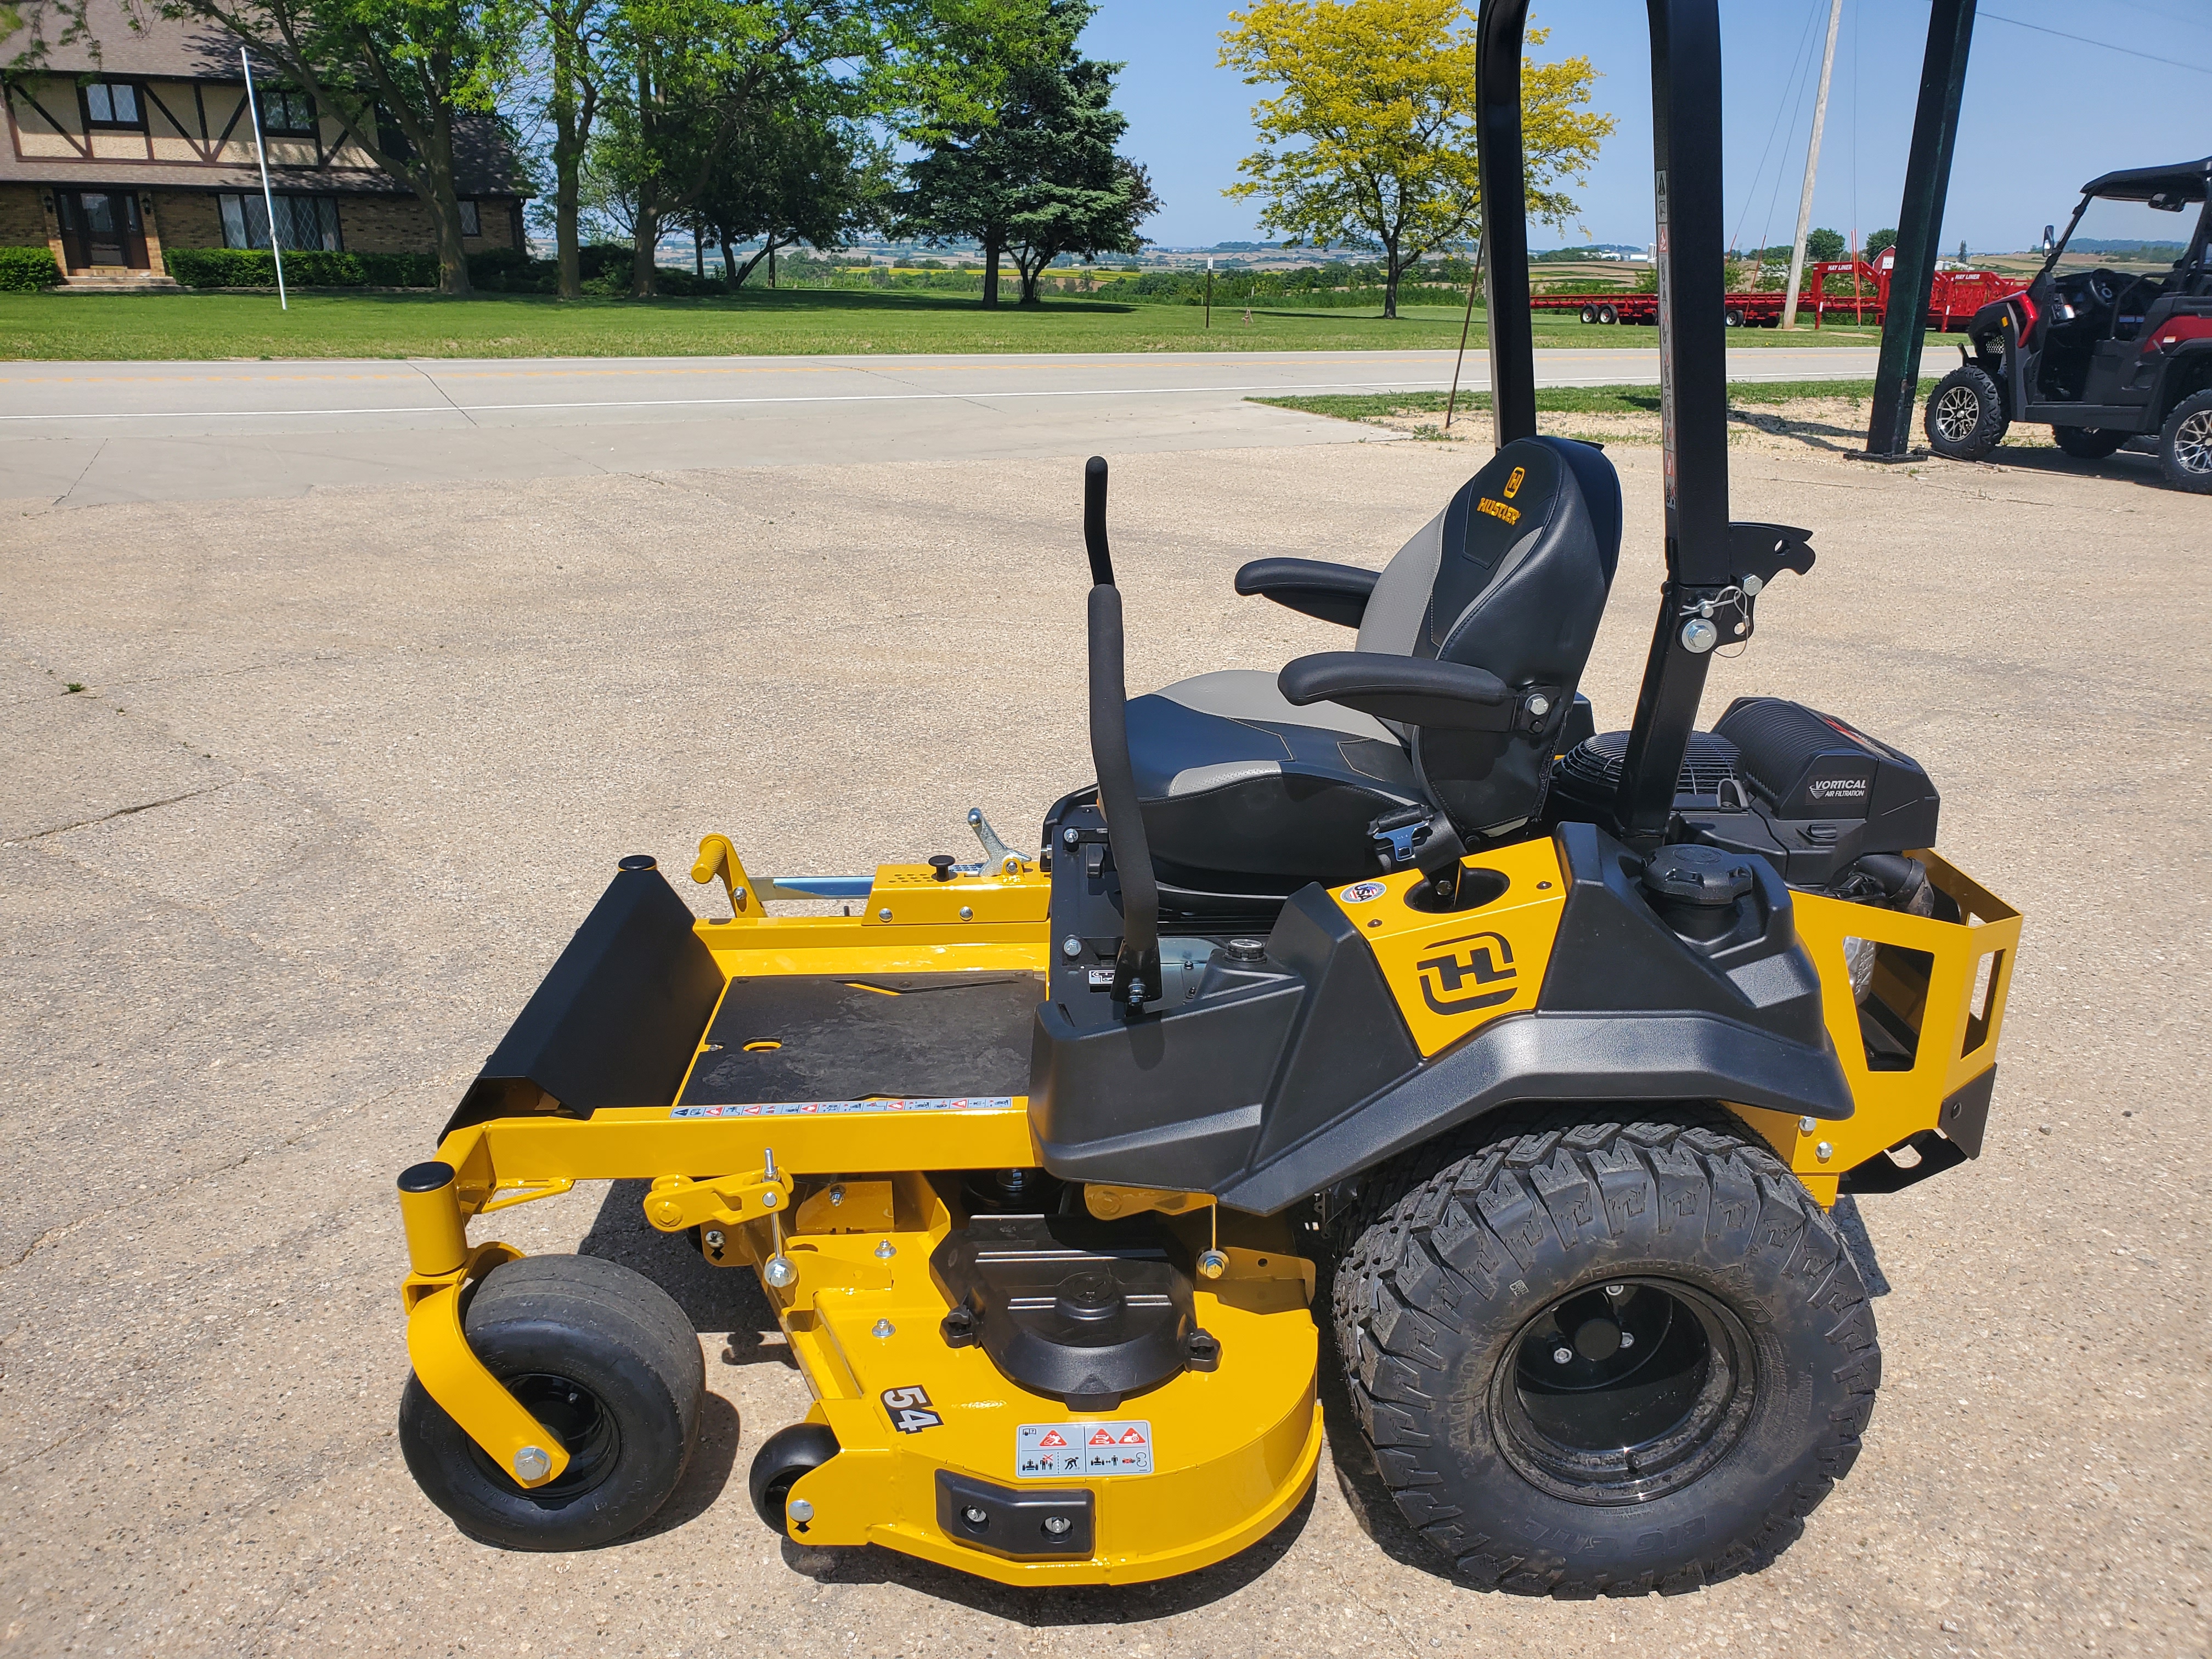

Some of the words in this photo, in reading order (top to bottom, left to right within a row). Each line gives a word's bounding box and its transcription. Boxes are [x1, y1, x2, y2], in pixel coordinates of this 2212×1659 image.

[1477, 498, 1520, 526] HUSTLER
[1815, 780, 1866, 789] VORTICAL
[1354, 883, 1373, 902] USA
[882, 1386, 940, 1432] 54
[1514, 1517, 1617, 1557] BITE
[1630, 1515, 1707, 1557] BIG
